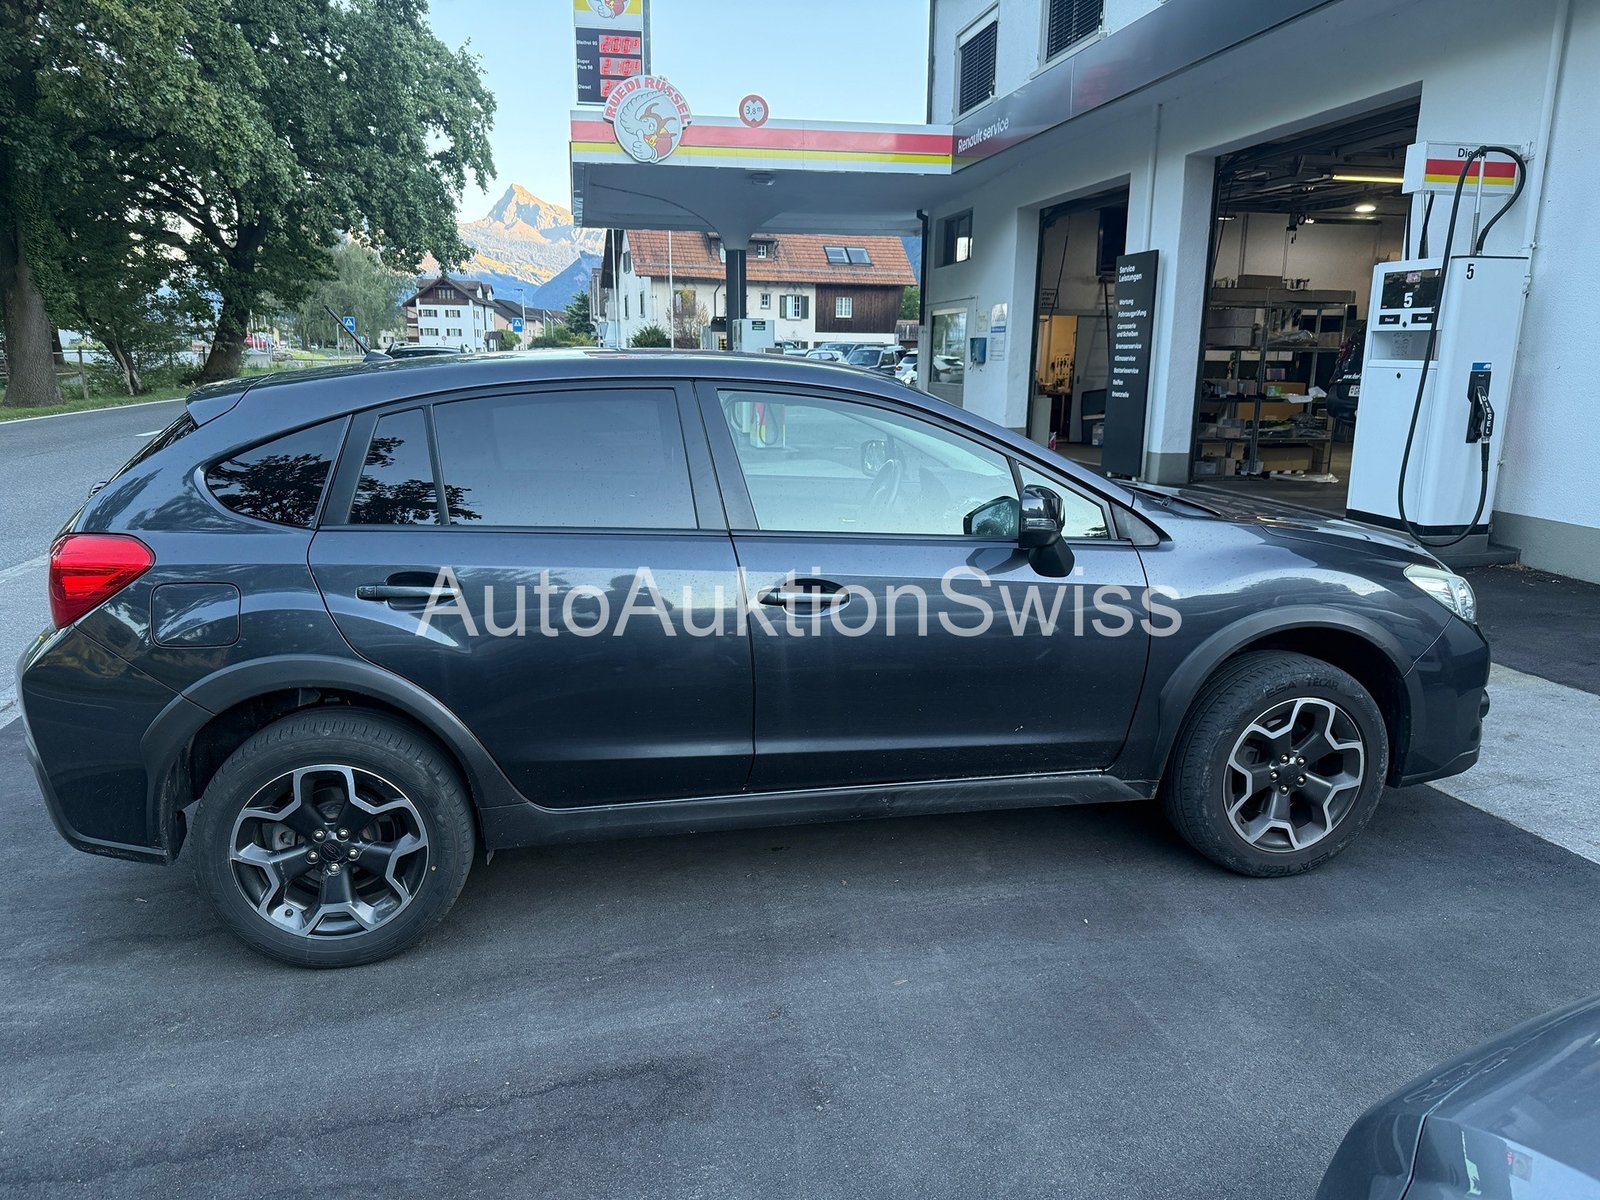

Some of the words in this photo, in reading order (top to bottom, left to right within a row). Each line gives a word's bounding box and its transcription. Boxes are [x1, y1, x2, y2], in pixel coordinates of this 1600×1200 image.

[605, 78, 641, 118] RUEDI
[644, 75, 691, 124] RÜSSEL
[957, 128, 983, 154] Renault
[982, 117, 1009, 141] service
[1457, 147, 1487, 159] Die
[1119, 265, 1135, 273] Service
[1466, 263, 1475, 280] 5
[1118, 274, 1142, 282] Leistungen
[1403, 292, 1414, 308] 5
[1481, 395, 1493, 434] DIESEL
